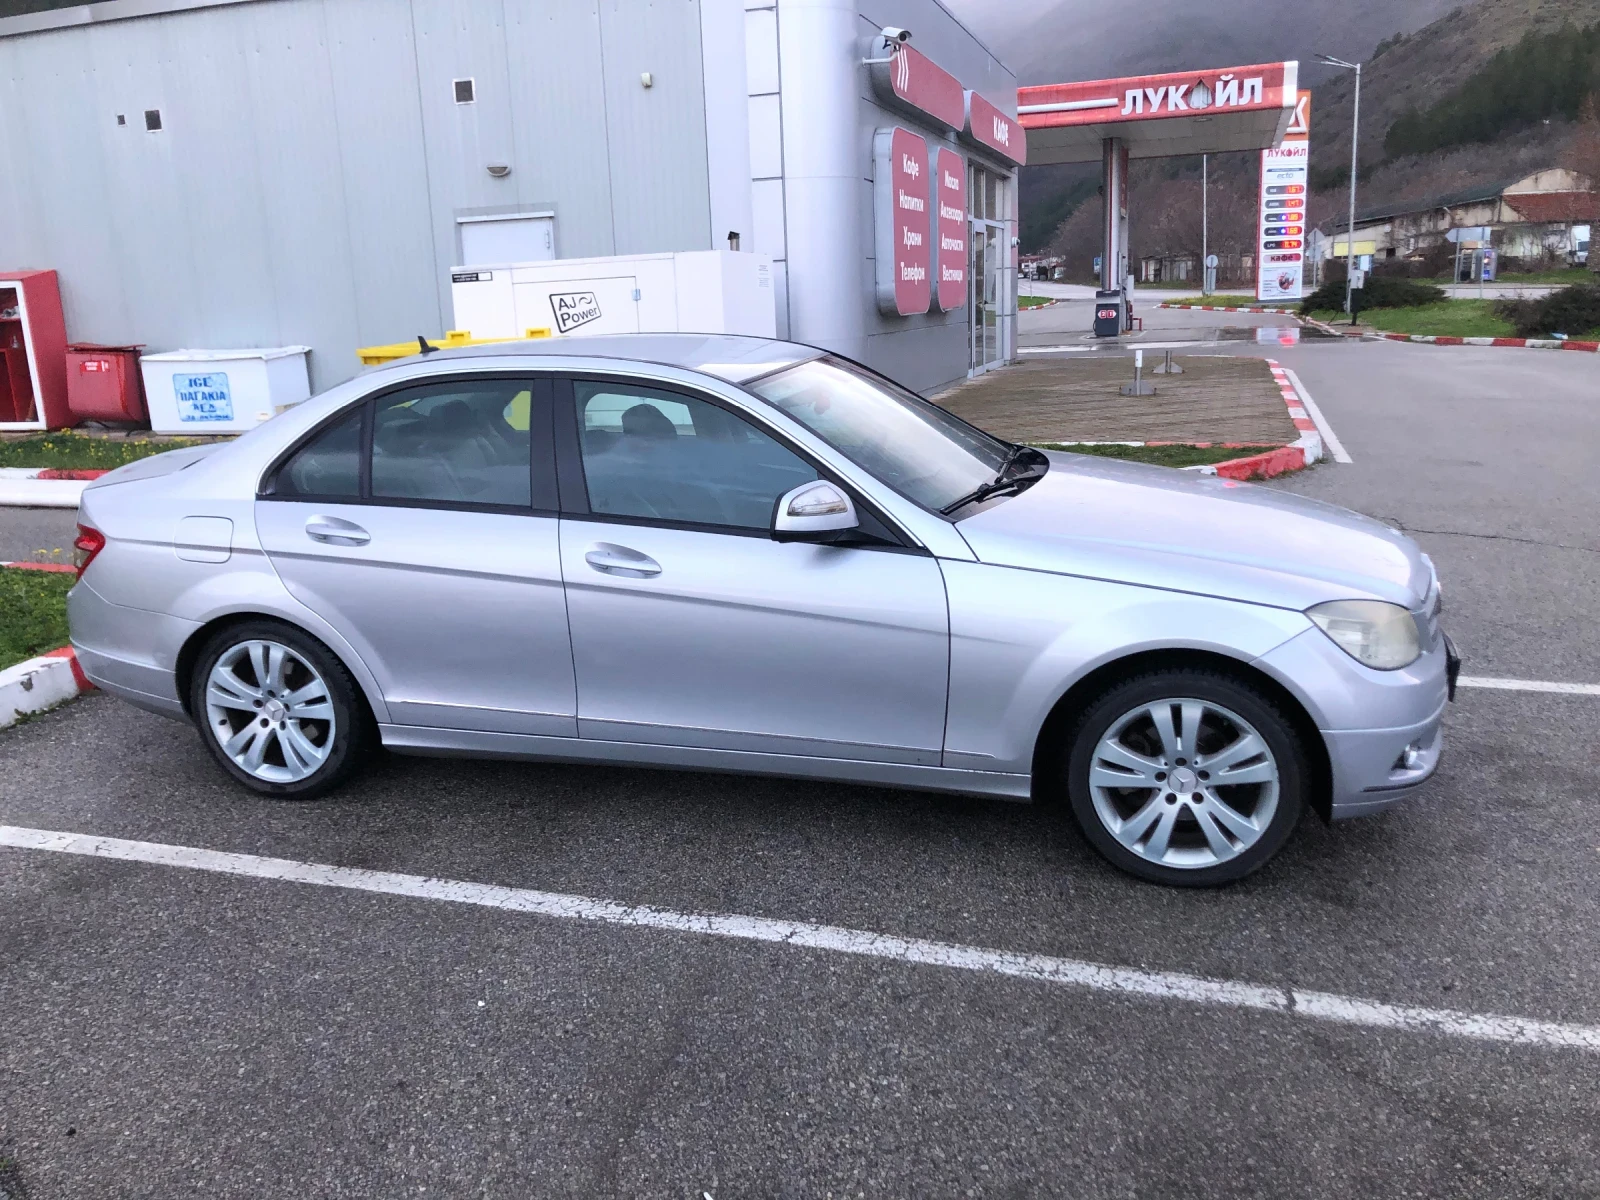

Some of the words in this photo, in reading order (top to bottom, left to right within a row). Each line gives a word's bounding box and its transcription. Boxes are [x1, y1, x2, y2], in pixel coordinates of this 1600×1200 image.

[1121, 74, 1263, 115] ЛУКОЙЛ
[993, 115, 1009, 148] КАФЕ
[902, 152, 919, 181] Кафе
[899, 188, 924, 212] Напитки
[903, 225, 922, 251] Храни
[900, 261, 925, 286] Телефон
[558, 296, 577, 311] AJ
[560, 307, 598, 327] Power
